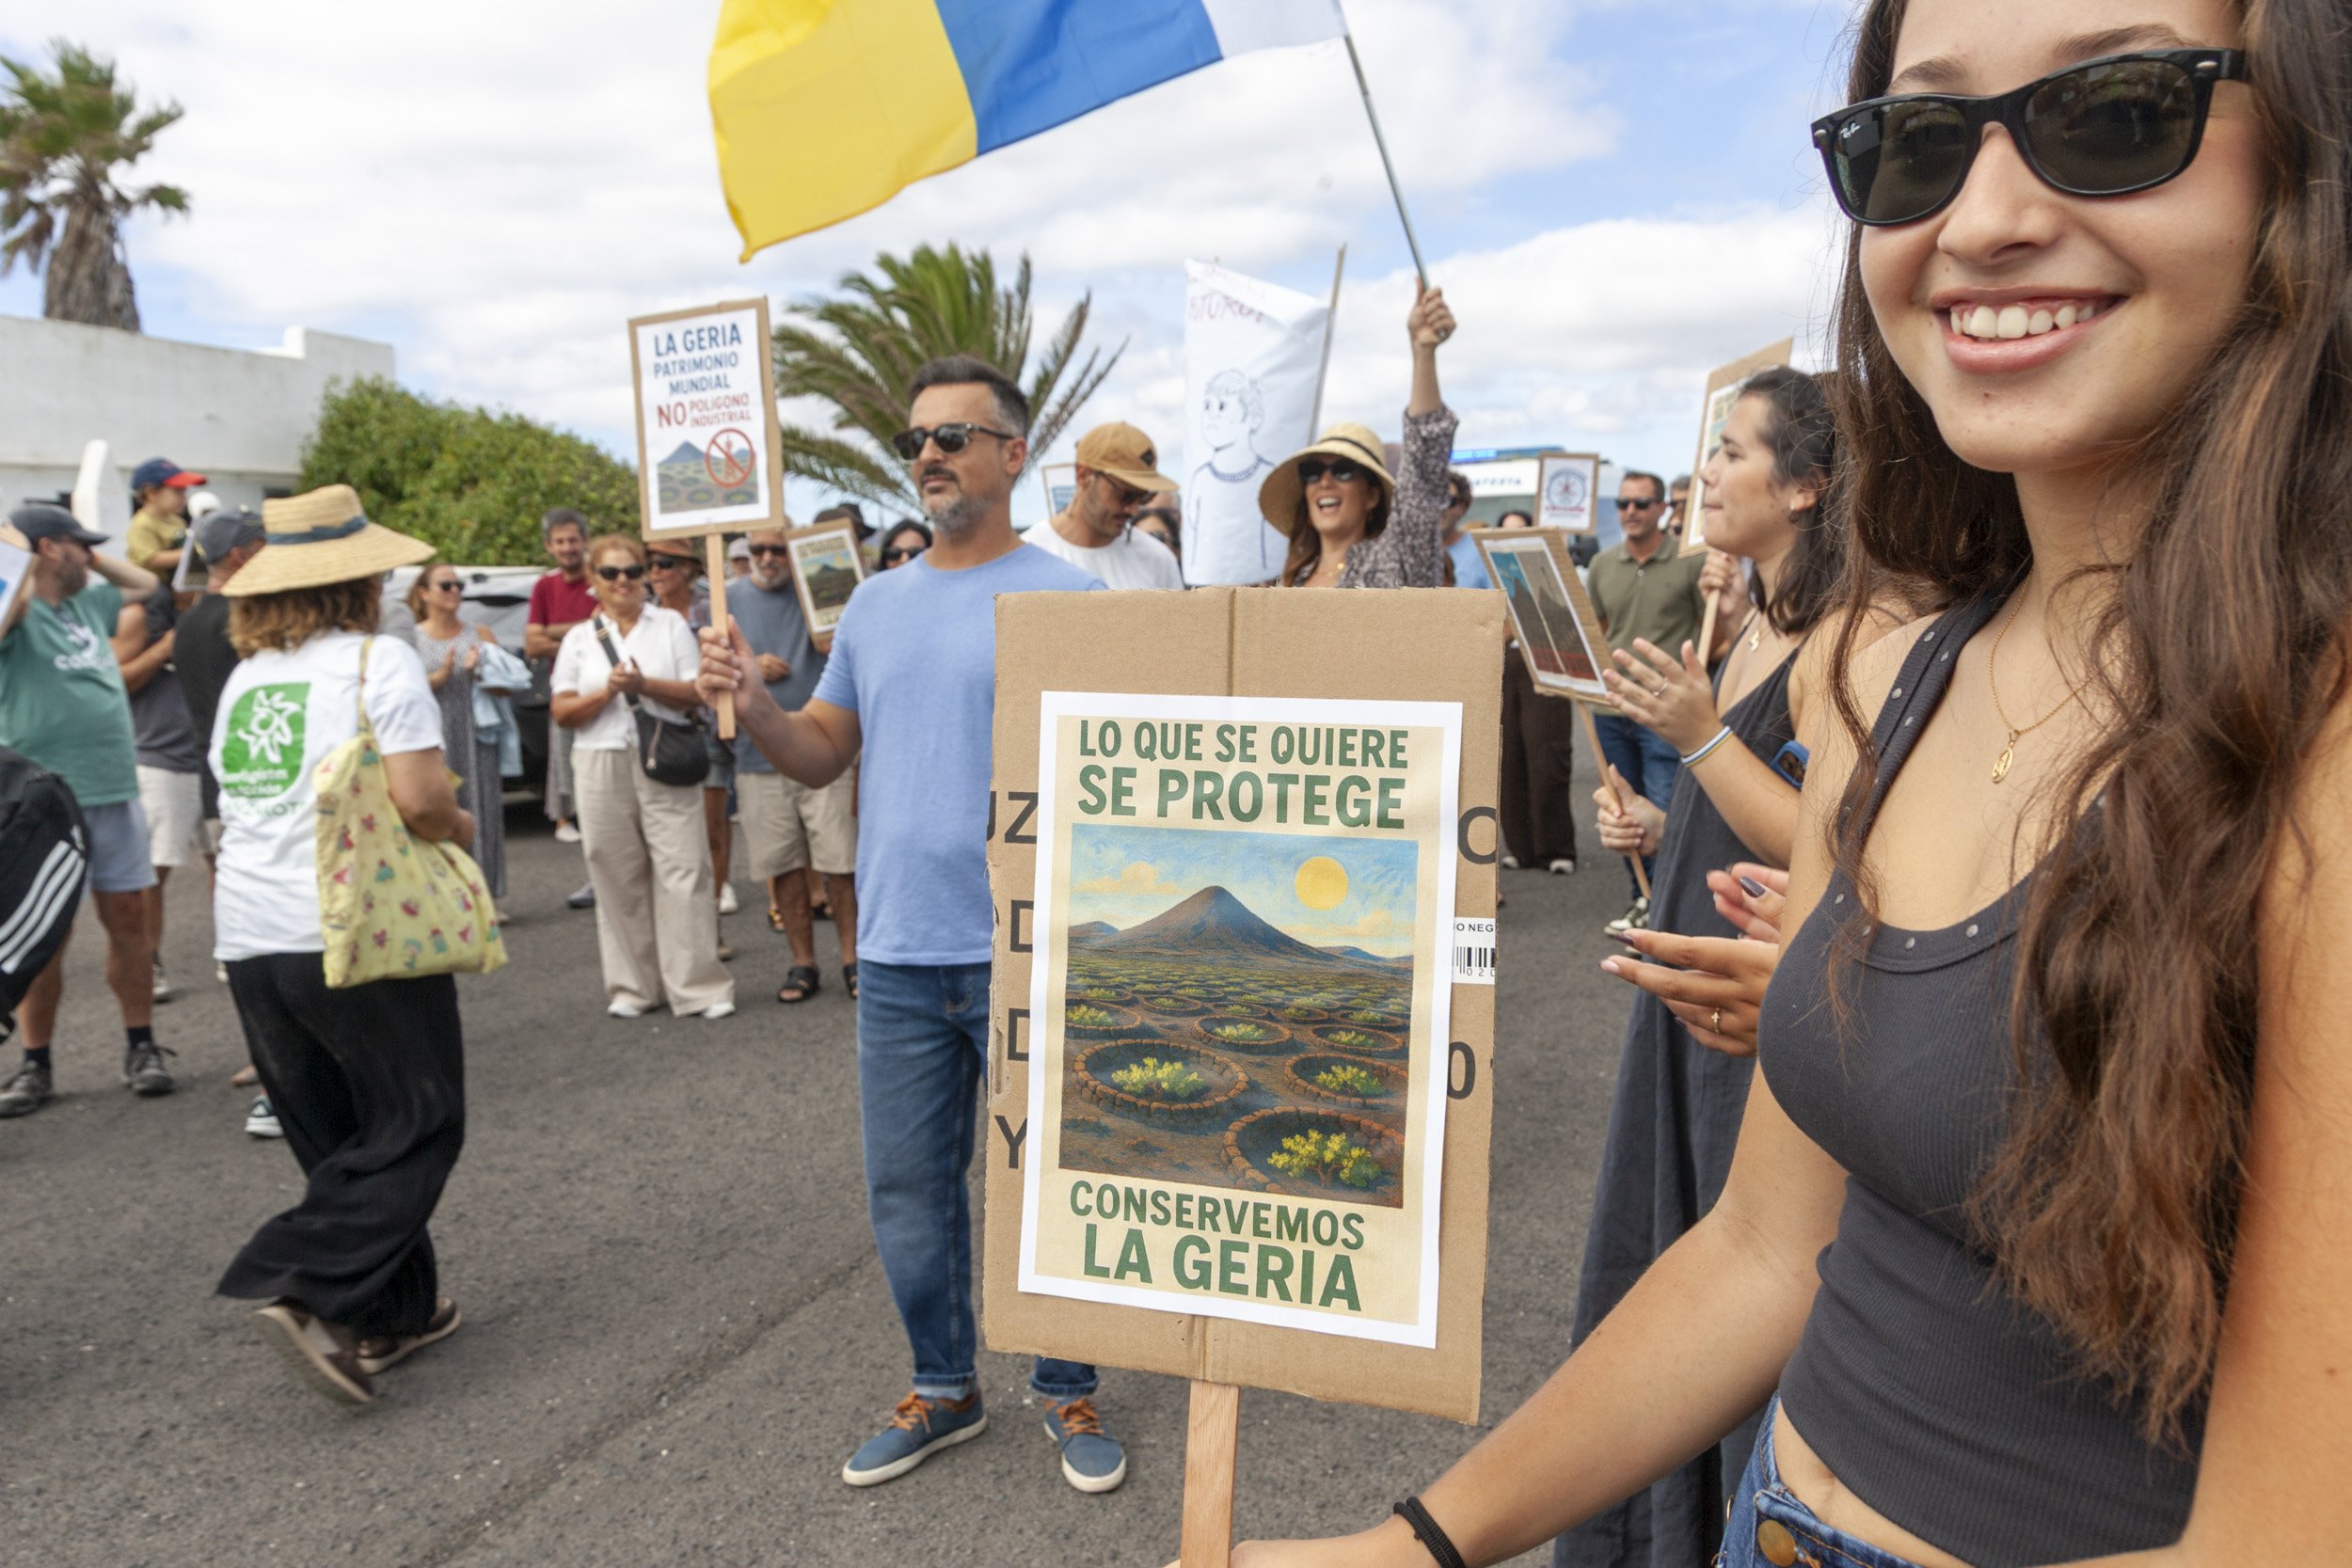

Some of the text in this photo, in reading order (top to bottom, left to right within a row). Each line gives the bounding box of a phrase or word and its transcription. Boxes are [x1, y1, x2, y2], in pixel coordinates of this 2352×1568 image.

[654, 323, 741, 356] LA GERIA
[654, 351, 739, 378] PATRIMONIO
[669, 373, 731, 395] MUNDIAL
[658, 402, 686, 428] NO
[690, 410, 752, 428] INDUSTRIAL
[1080, 720, 1408, 768] LO QUE SE QUIERE
[1078, 764, 1406, 830] SE PROTEGE
[1070, 1180, 1365, 1250] CONSERVEMOS
[1084, 1223, 1361, 1311] LA GERIA
